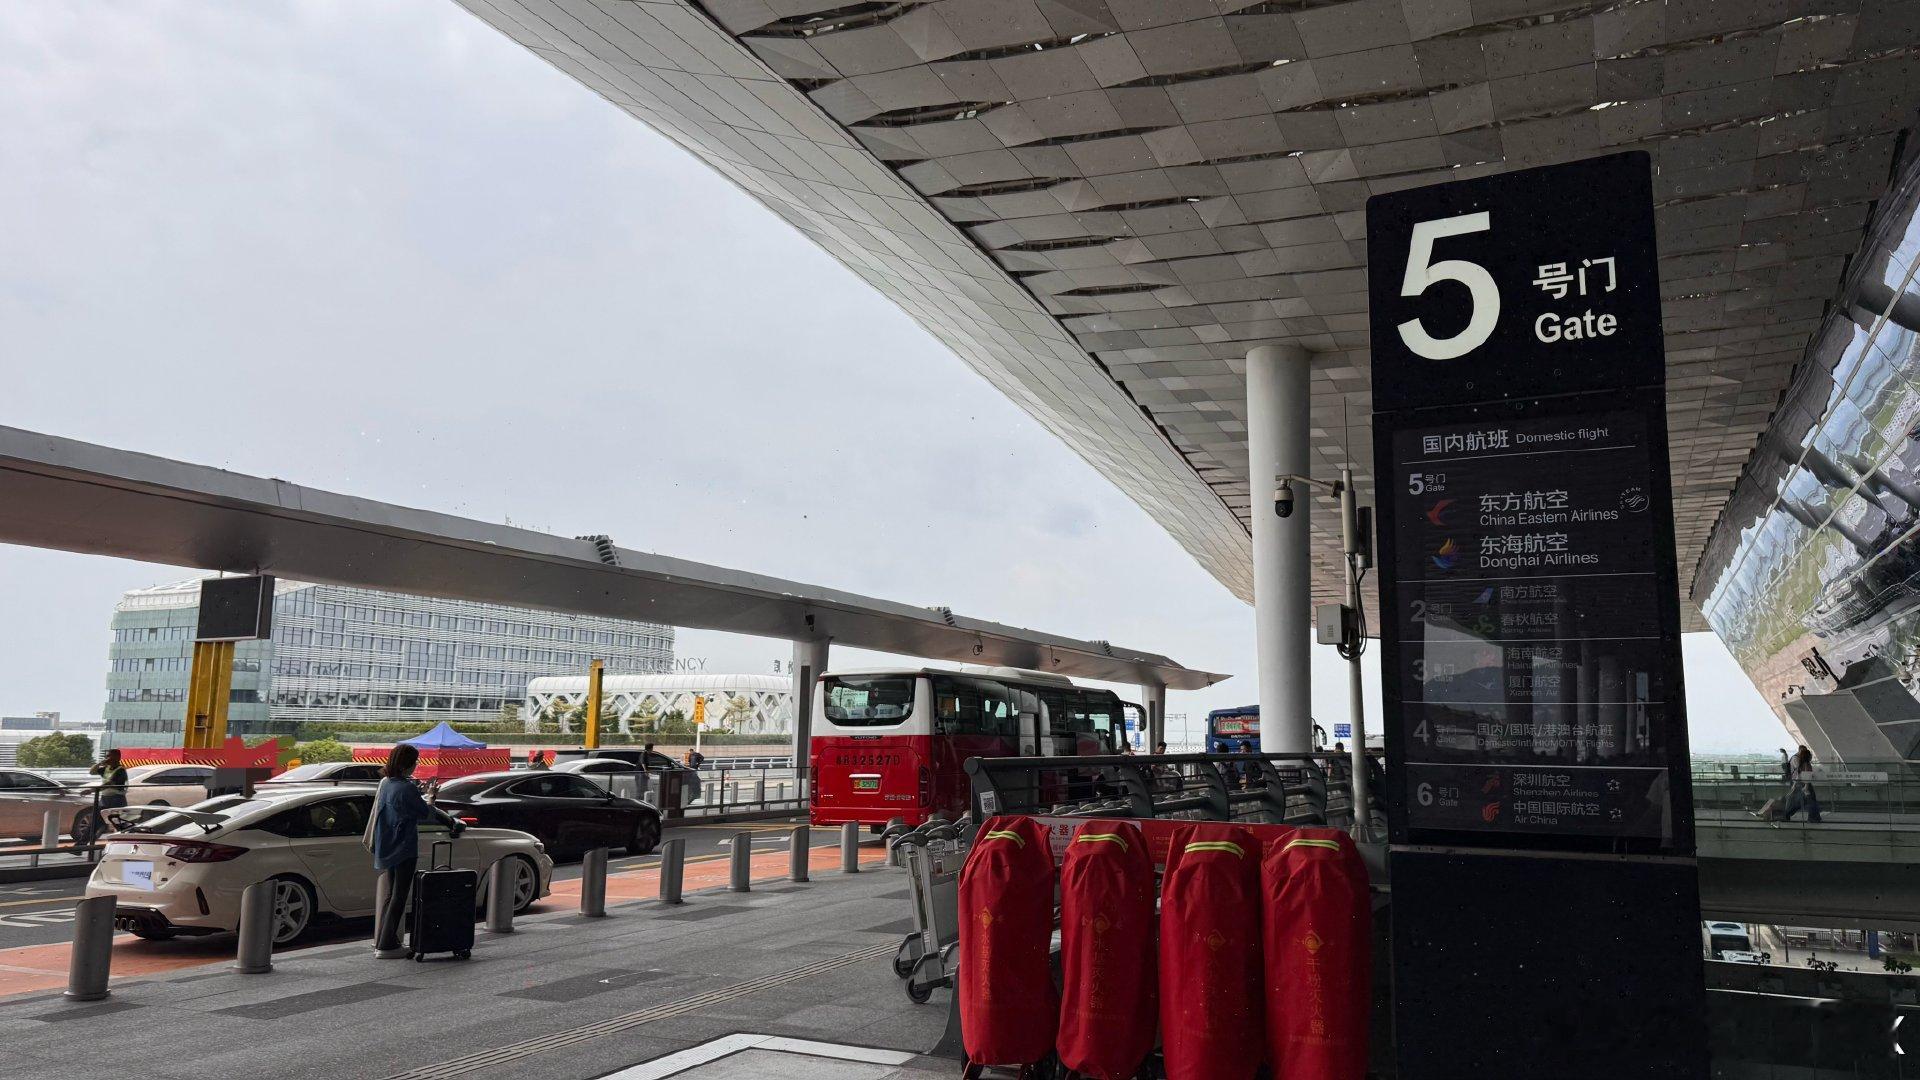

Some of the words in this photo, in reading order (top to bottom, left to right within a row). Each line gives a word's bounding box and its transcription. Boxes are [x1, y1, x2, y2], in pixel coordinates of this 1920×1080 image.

[1398, 211, 1500, 360] 5
[1533, 256, 1617, 300] 号门
[1535, 307, 1618, 343] Gate
[1423, 429, 1510, 455] 国内航班
[1516, 431, 1576, 444] Domestic
[1578, 427, 1609, 441] flight
[1408, 473, 1425, 495] 5
[1425, 473, 1446, 484] 号门
[1425, 483, 1445, 492] Gate
[1479, 489, 1569, 513] 东方航空
[1480, 513, 1516, 526] China
[1518, 512, 1567, 525] Eastern
[1571, 508, 1619, 522] Airlines
[1480, 531, 1569, 555] 东海航空
[1480, 555, 1540, 571] Donghai
[1544, 551, 1599, 566] Airlines
[1500, 584, 1558, 599] 南方航空
[1410, 600, 1426, 621] 2
[1501, 612, 1559, 626] 春秋航空
[1506, 647, 1563, 660] 海南航空
[1413, 660, 1427, 681] 3
[1509, 674, 1561, 688] 厦门航空
[1413, 720, 1430, 746] 4
[1513, 773, 1571, 788] 深圳航空
[1416, 782, 1433, 807] 6
[1438, 787, 1459, 799] 号门
[1513, 787, 1561, 798] Shenzhen
[1564, 787, 1599, 798] Airlines
[1438, 797, 1459, 808] Gate
[1513, 800, 1601, 816] 中国国际航空
[1514, 815, 1528, 825] Air
[1530, 815, 1558, 826] China
